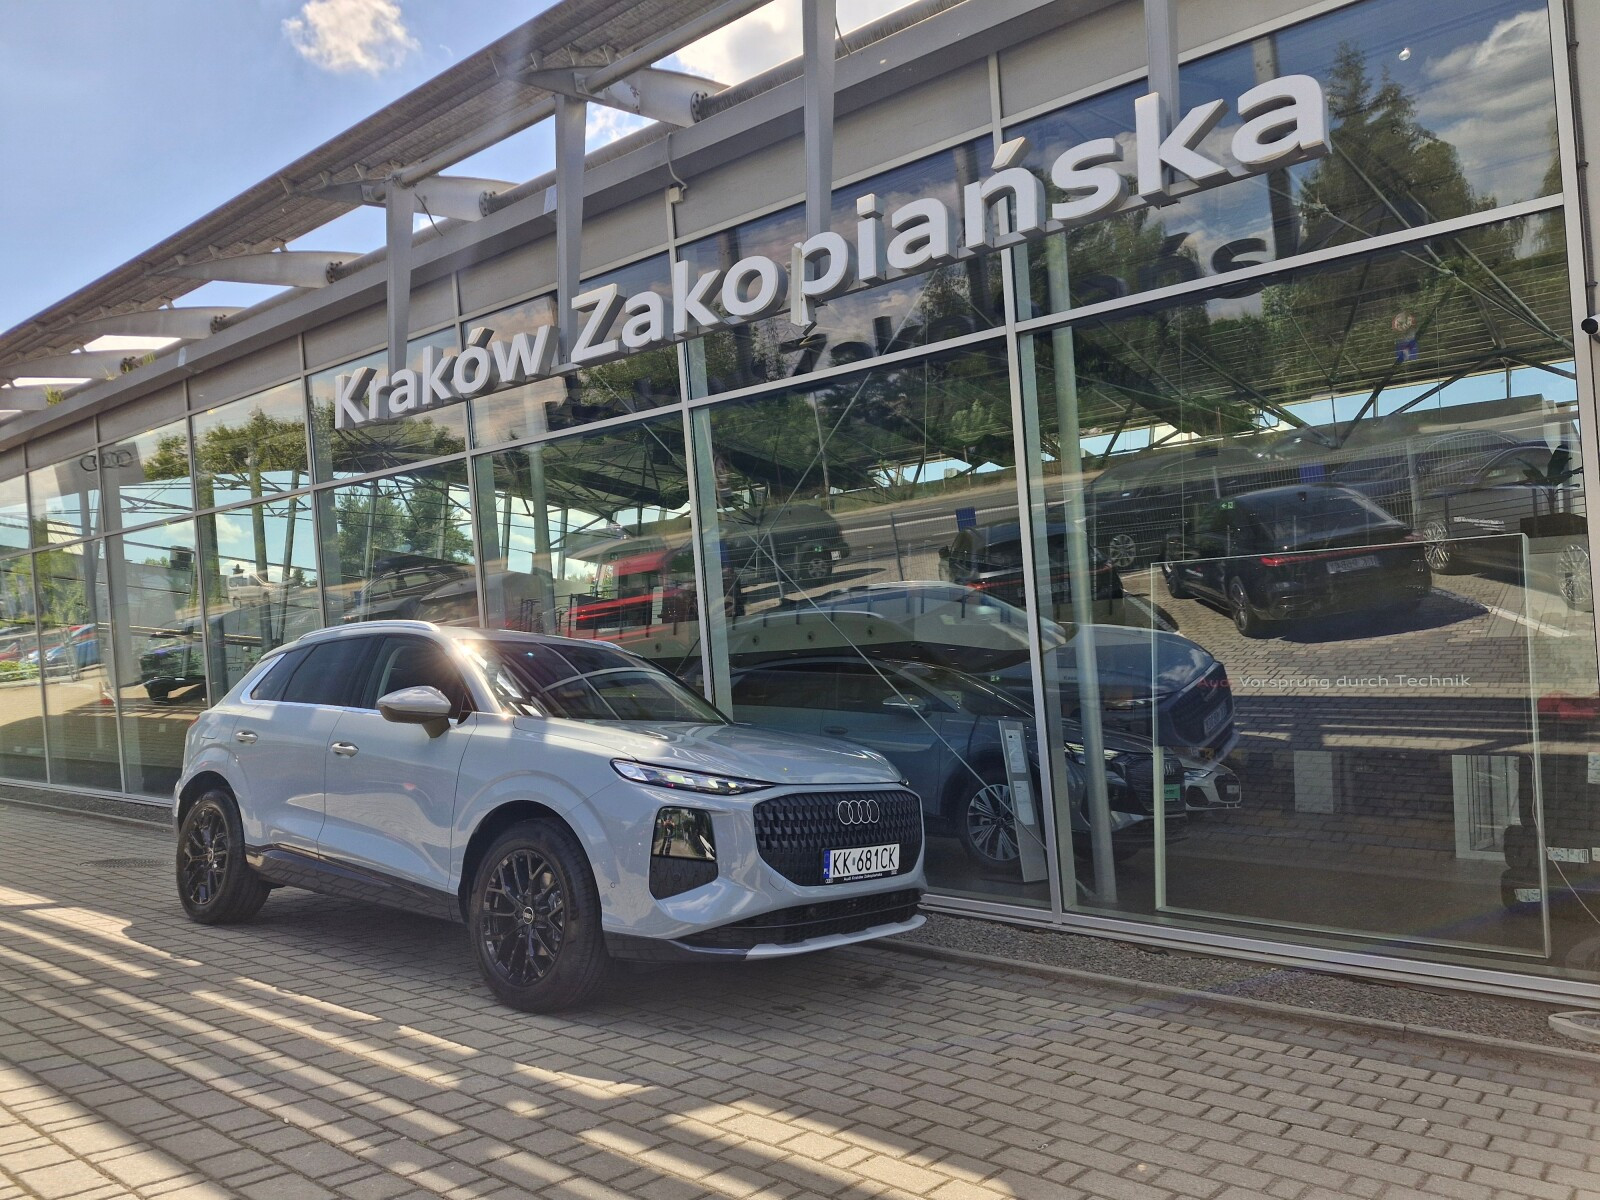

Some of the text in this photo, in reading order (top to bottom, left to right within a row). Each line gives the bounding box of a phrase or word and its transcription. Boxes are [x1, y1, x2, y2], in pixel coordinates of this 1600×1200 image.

[335, 74, 1332, 430] Kraków Zakopiańska
[1239, 676, 1331, 690] Vorsprung
[1336, 675, 1389, 688] durch
[1395, 674, 1472, 688] Technik
[833, 846, 896, 876] KK 681CK
